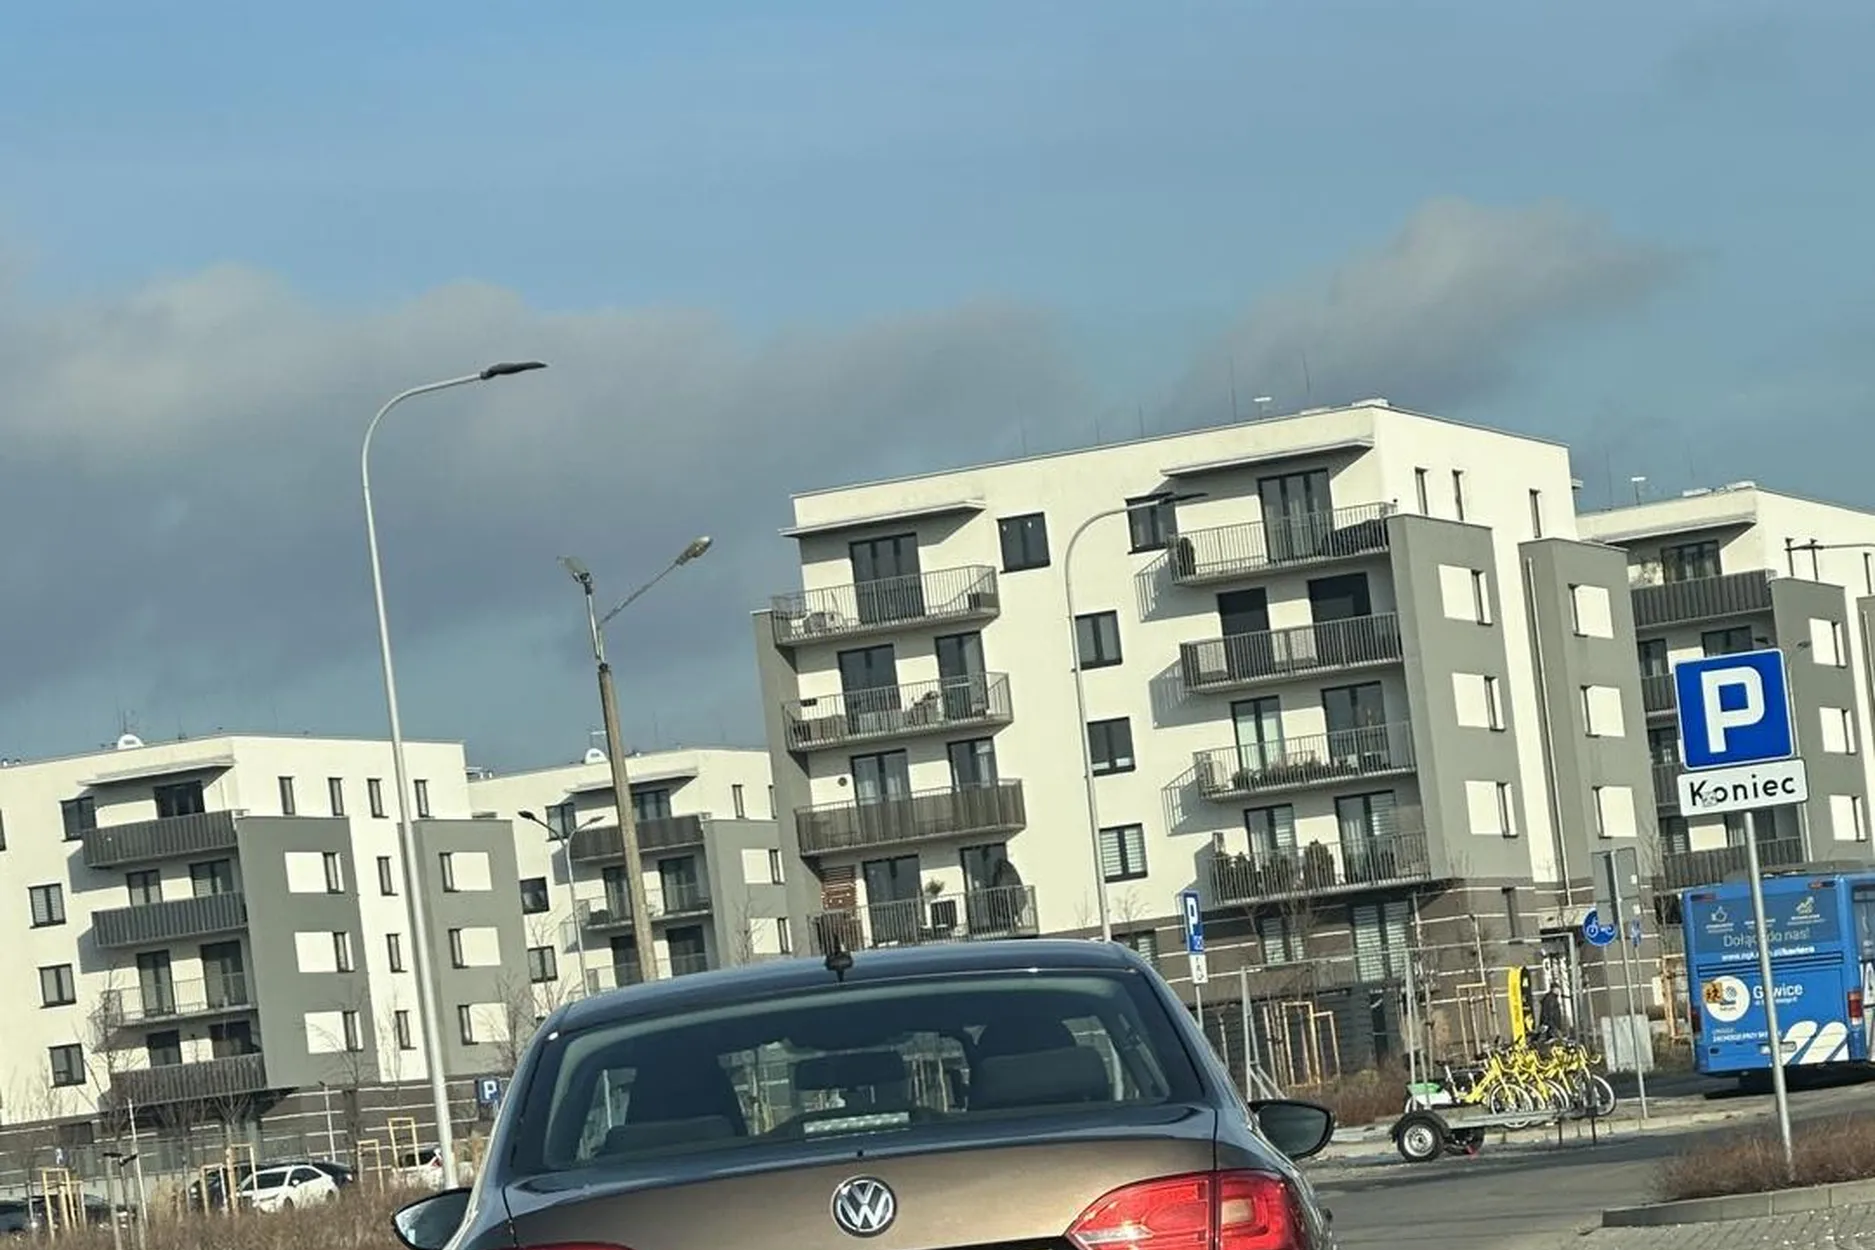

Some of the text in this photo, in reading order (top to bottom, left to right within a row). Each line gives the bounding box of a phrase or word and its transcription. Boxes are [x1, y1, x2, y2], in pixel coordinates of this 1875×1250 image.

[1700, 666, 1766, 754] P
[1689, 774, 1796, 806] Koniec
[1186, 897, 1199, 936] P
[1753, 983, 1804, 999] Gwice
[483, 1080, 498, 1100] P
[836, 1179, 893, 1233] VW
